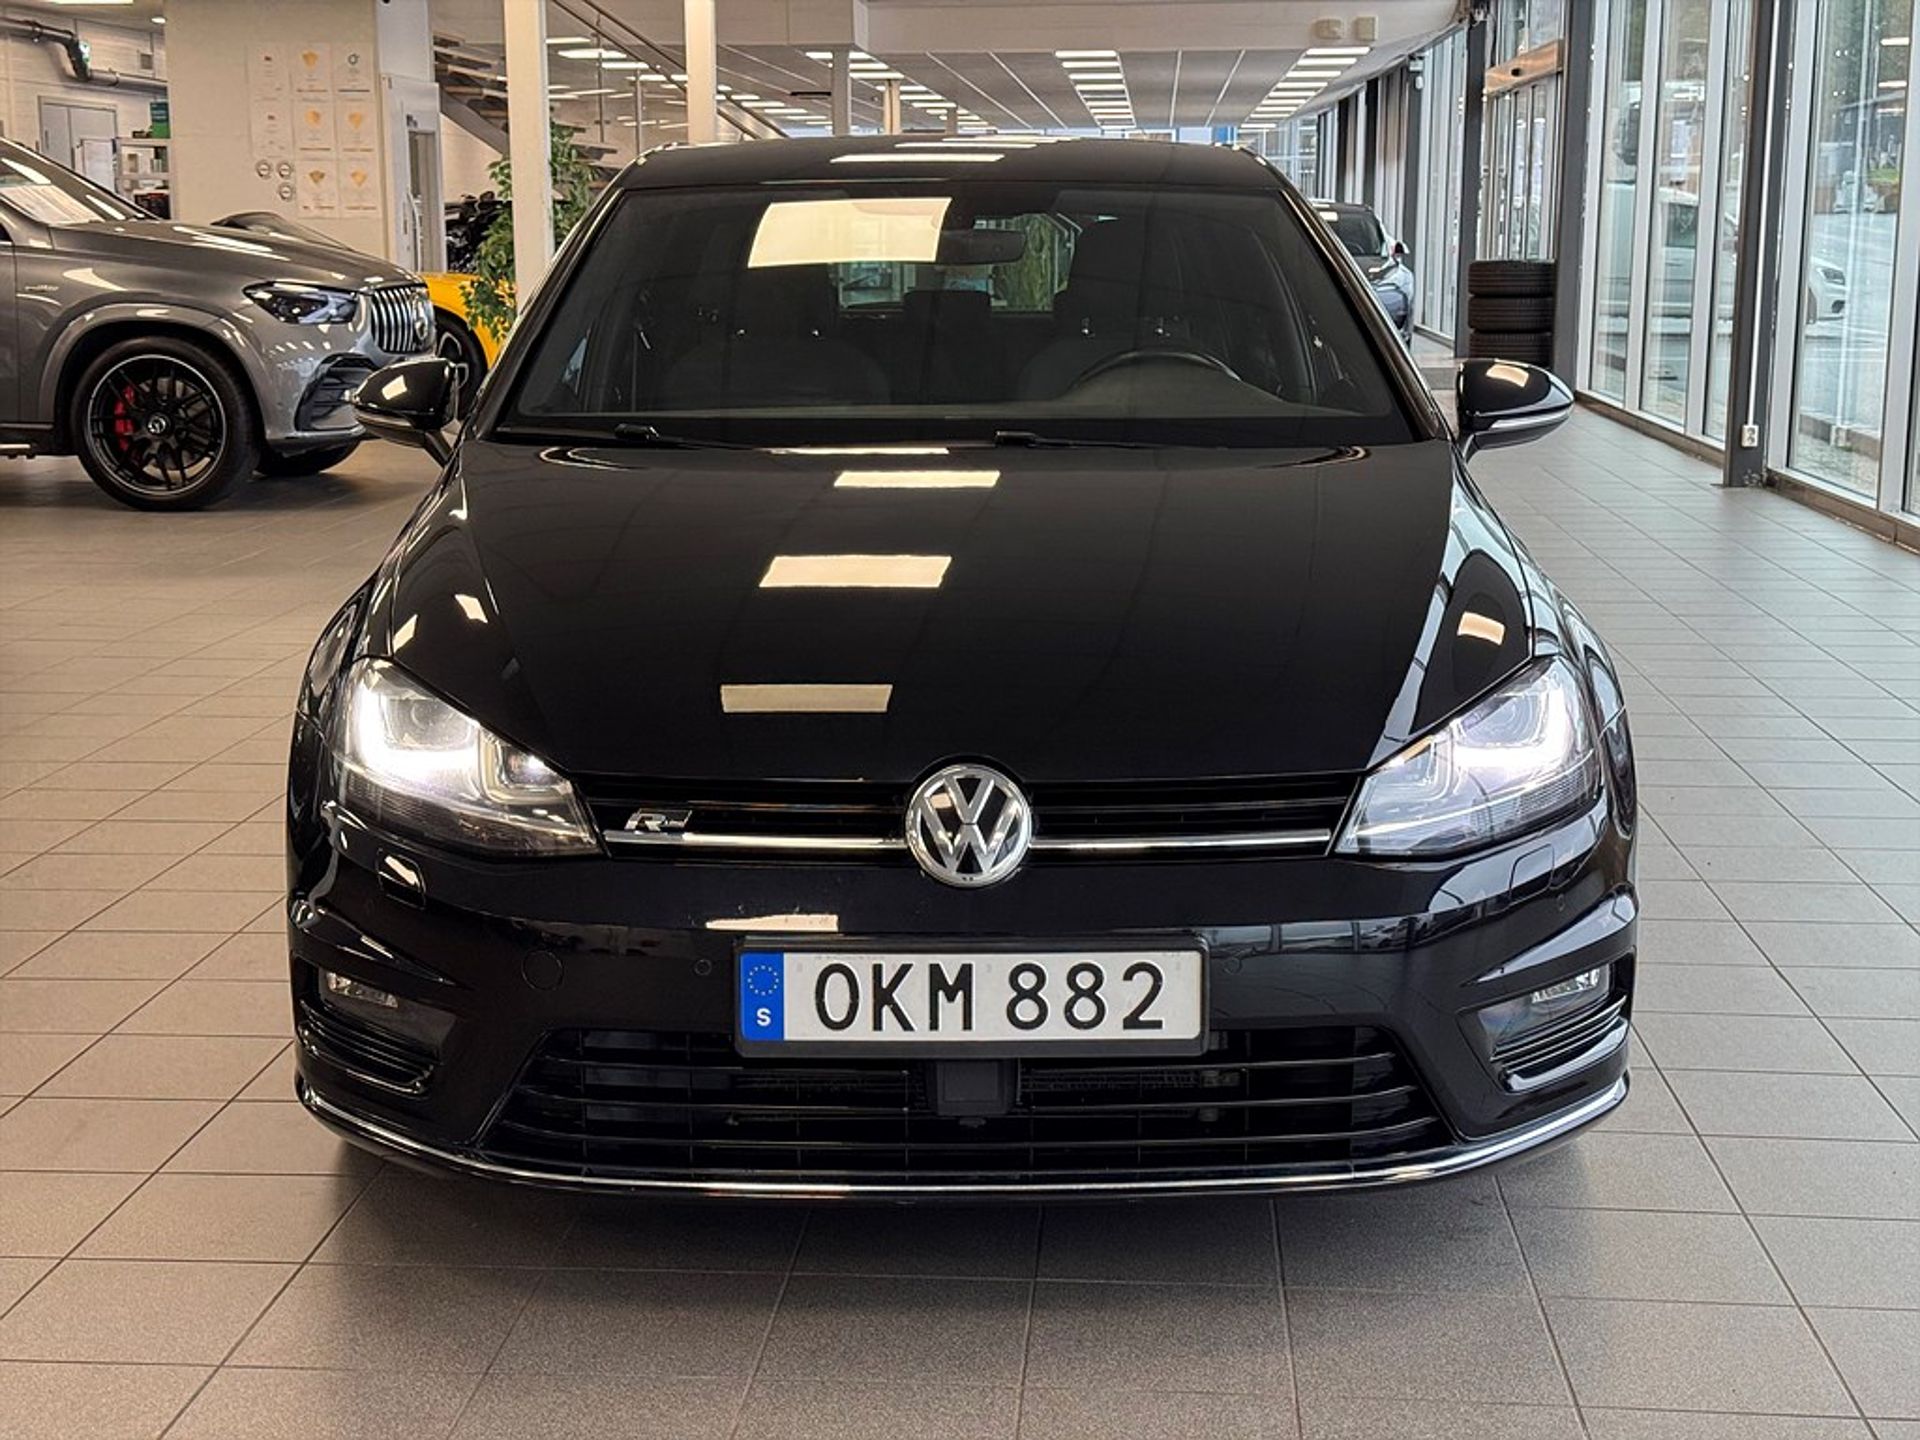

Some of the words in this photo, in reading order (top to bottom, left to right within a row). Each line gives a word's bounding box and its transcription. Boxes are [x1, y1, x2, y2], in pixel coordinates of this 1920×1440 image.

[756, 1007, 772, 1027] S
[815, 962, 974, 1032] OKM
[1006, 961, 1164, 1031] 882
